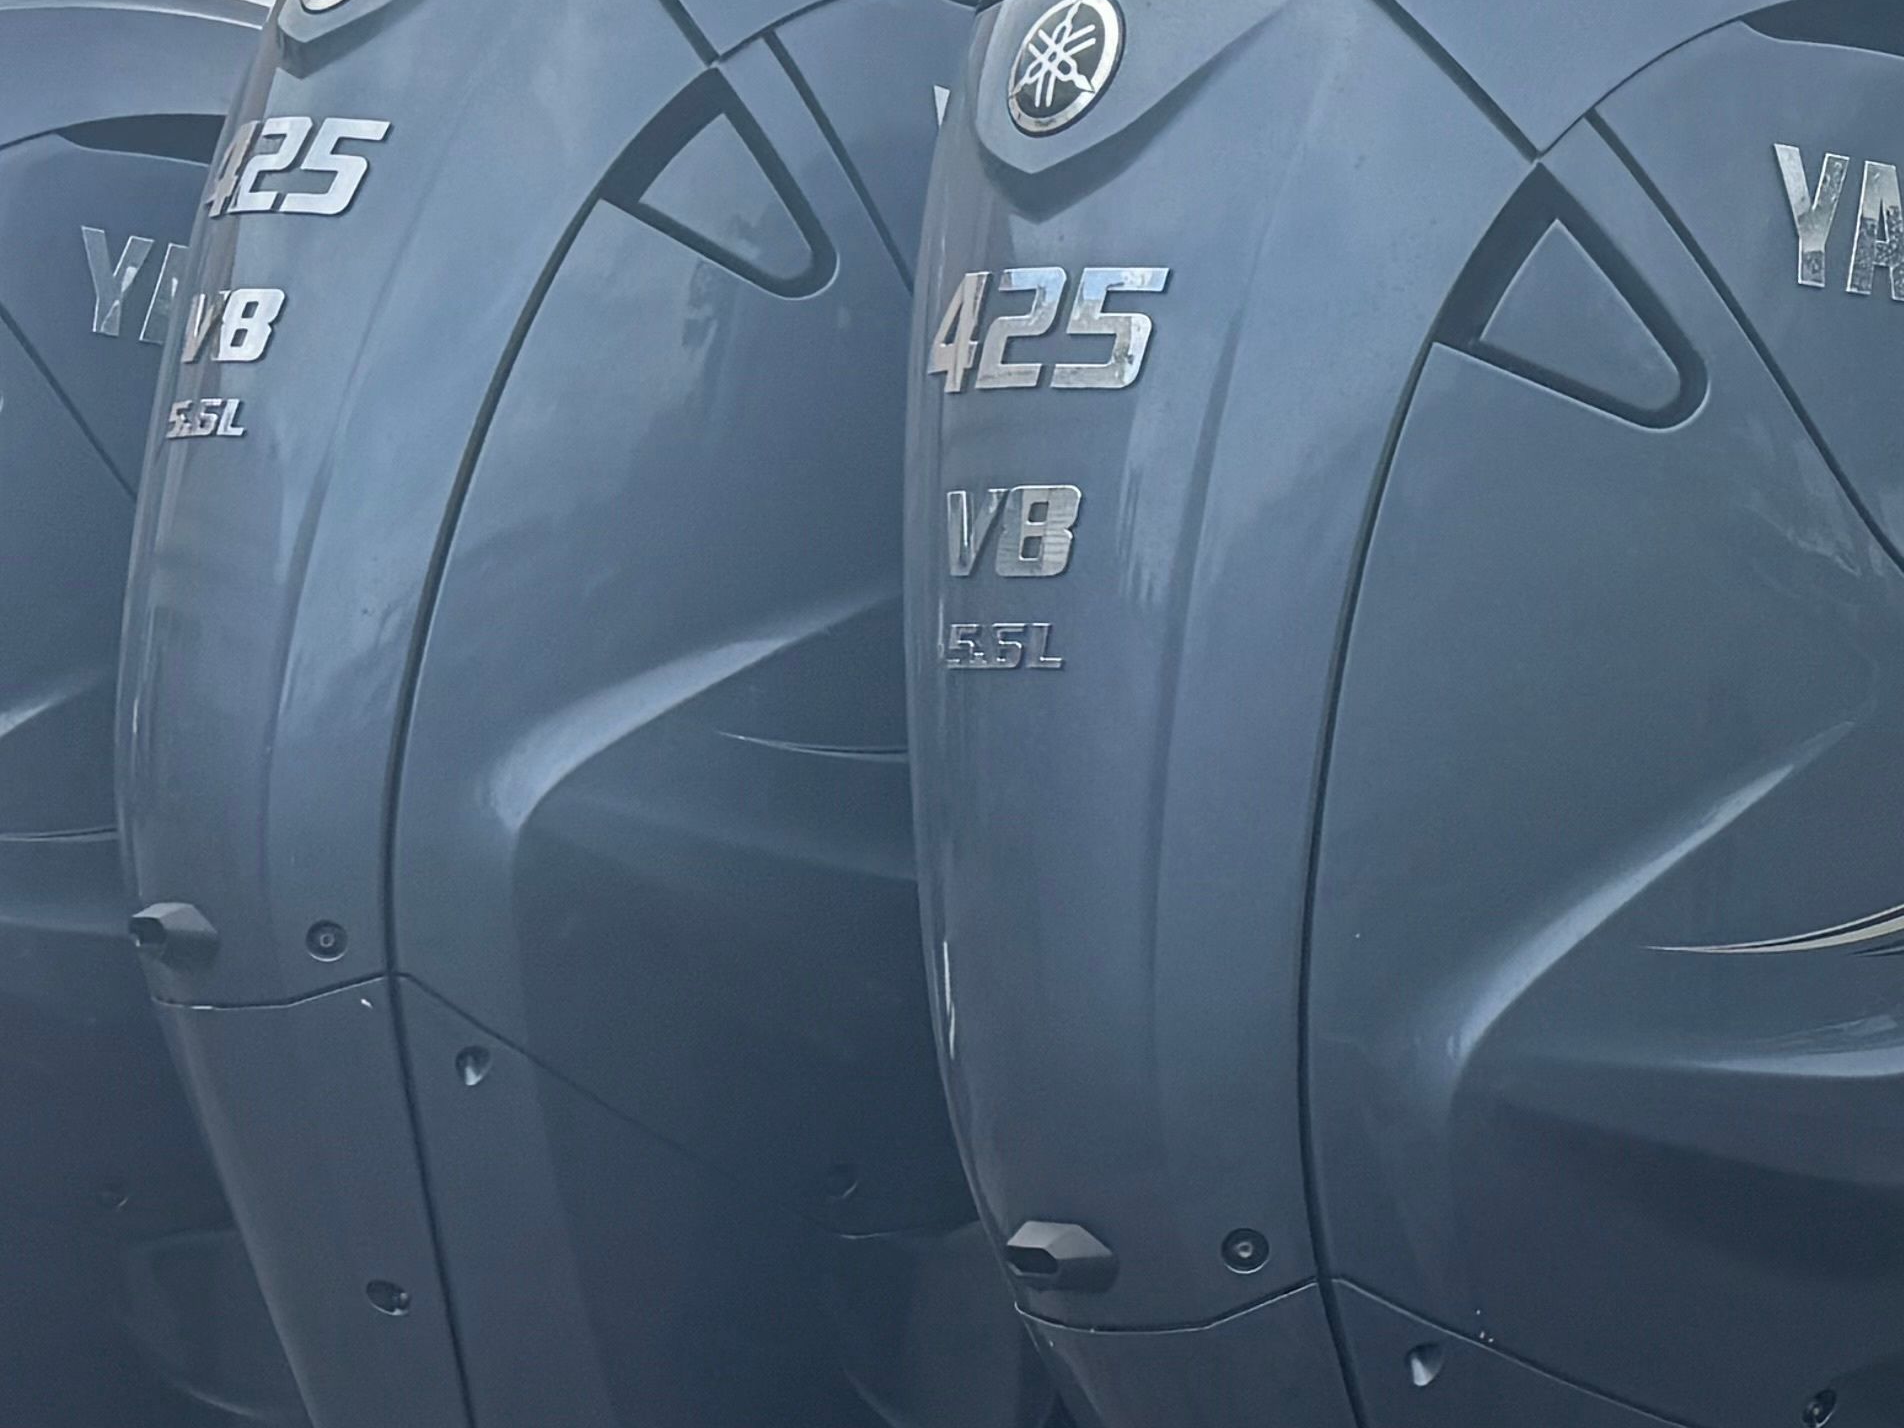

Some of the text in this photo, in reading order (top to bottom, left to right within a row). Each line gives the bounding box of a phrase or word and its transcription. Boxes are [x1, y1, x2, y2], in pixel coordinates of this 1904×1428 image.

[205, 116, 390, 217] 425
[181, 288, 285, 364] V8
[927, 266, 1170, 393] 425
[946, 484, 1082, 577] V8
